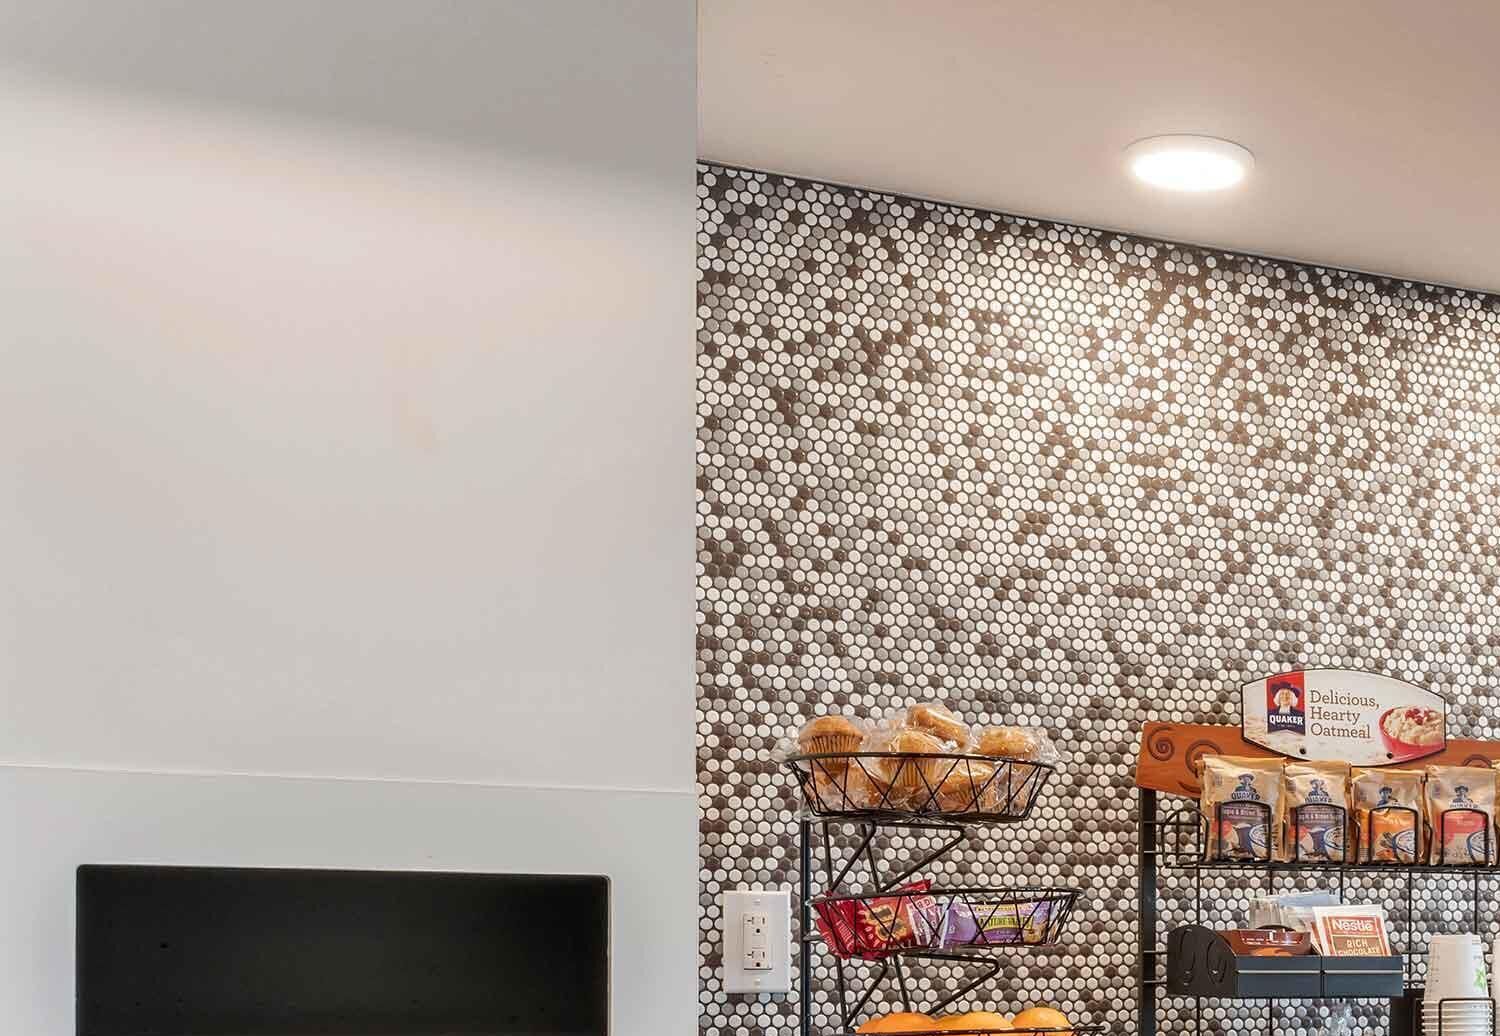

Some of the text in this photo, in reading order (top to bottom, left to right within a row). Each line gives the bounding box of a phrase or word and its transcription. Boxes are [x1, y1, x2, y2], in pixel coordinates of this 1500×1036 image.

[1310, 690, 1380, 709] Delicious,
[1269, 714, 1304, 726] QUAKER
[1310, 706, 1361, 725] Hearty
[1310, 722, 1371, 739] Oatmeal
[1346, 938, 1369, 949] RICH
